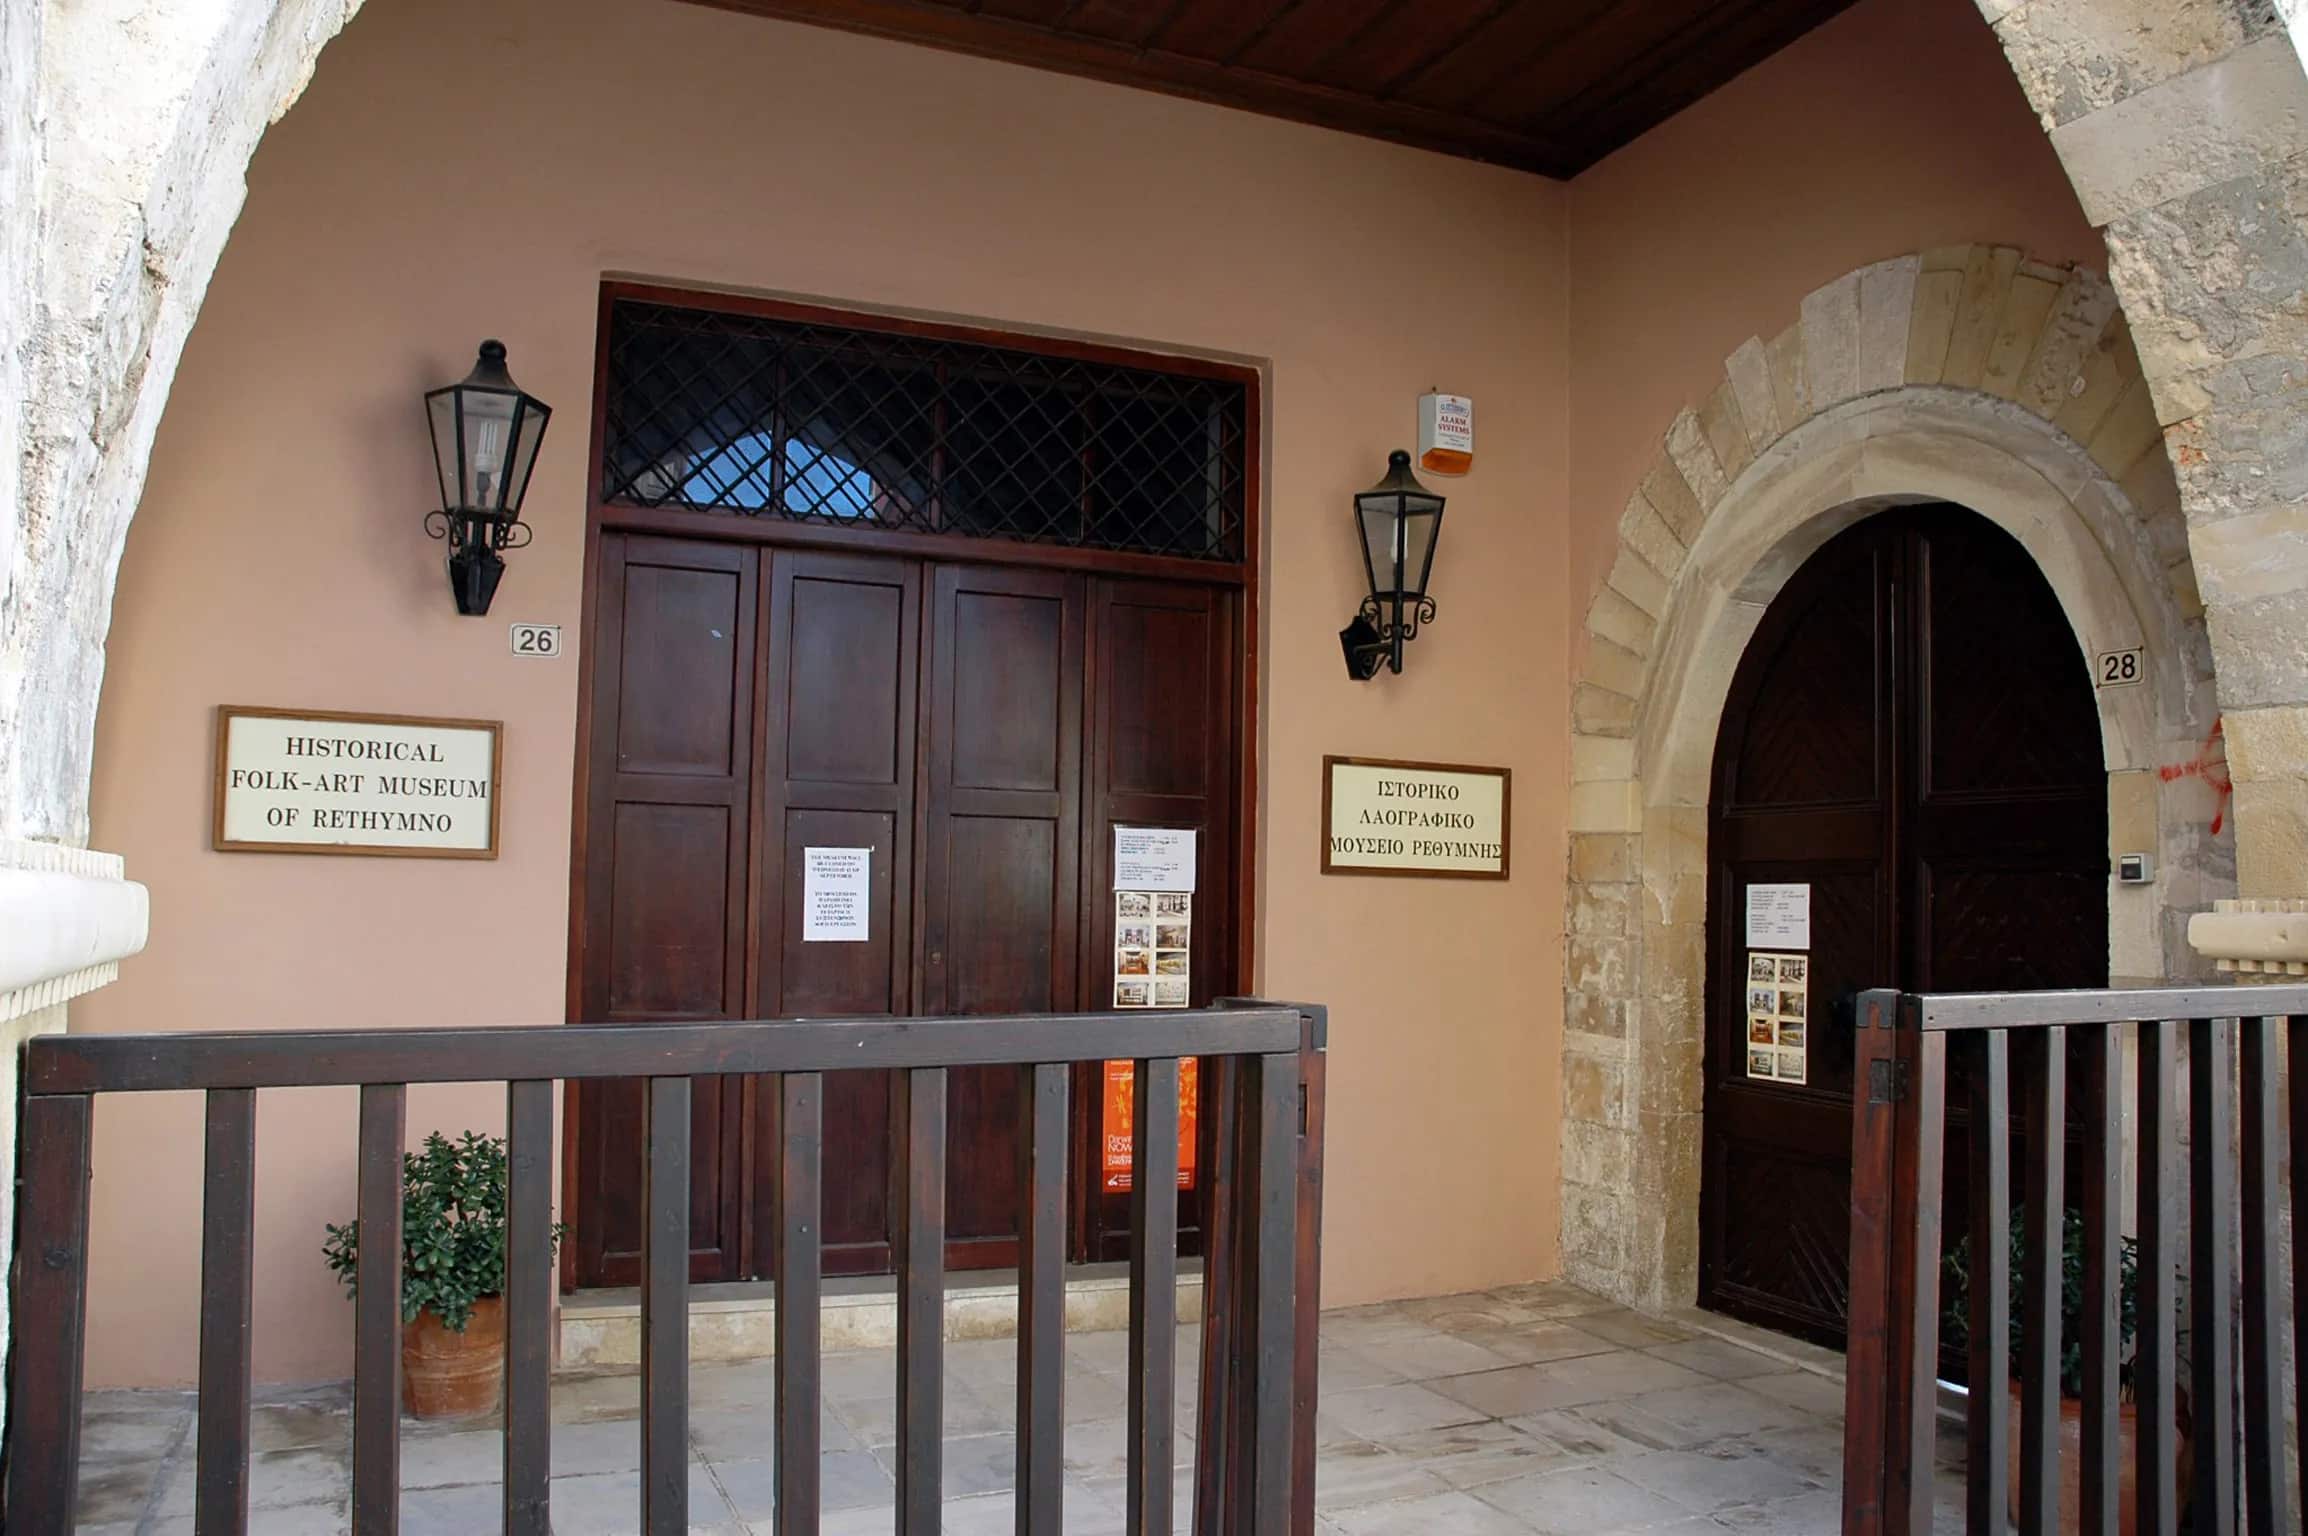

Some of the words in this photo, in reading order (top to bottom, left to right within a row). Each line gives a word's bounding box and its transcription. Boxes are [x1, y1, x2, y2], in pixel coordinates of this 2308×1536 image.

[1438, 423, 1470, 434] SYSTEMS
[1441, 415, 1466, 425] ALARM
[520, 629, 552, 652] 26
[2105, 653, 2135, 680] 28
[286, 736, 444, 762] HISTORICAL
[231, 769, 364, 793] FOLK-ART
[378, 776, 487, 798] MUSEUM
[1378, 780, 1459, 800] ΙΣΤΟΡΙΚΟ
[267, 807, 299, 827] OF
[313, 809, 451, 832] RETHYMNO
[1359, 809, 1474, 829] ΛΑΟΓΡΑΦΙΚΟ
[1331, 836, 1404, 855] ΜΟΥΣΕΙΟ
[1412, 840, 1502, 859] ΡΕΘΥΜΝΗΣ
